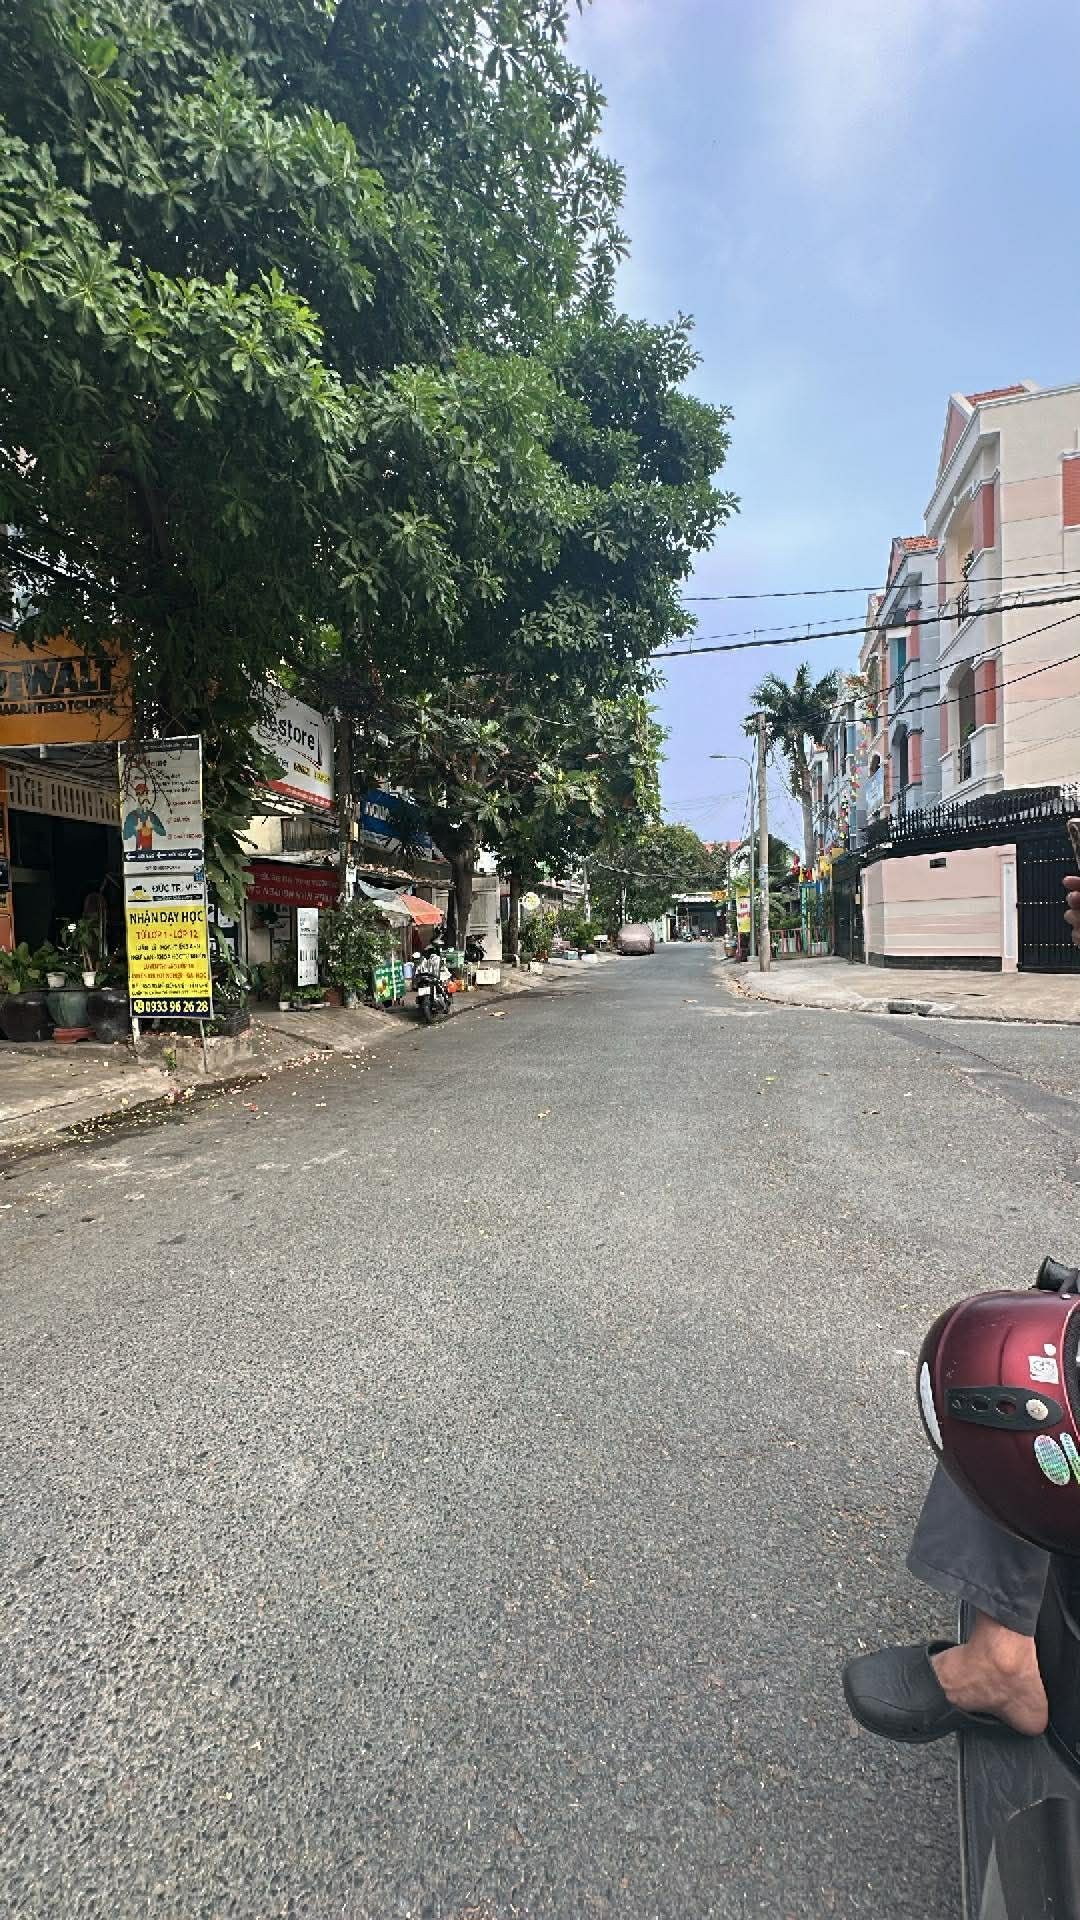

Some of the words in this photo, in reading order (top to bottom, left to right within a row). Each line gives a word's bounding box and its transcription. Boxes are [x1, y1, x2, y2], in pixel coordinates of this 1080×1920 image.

[129, 909, 158, 927] NHẬN
[159, 911, 179, 927] DẠY
[181, 909, 204, 926] HỌC
[189, 929, 199, 939] 12
[146, 1001, 168, 1013] 0933
[169, 1001, 181, 1013] 96
[182, 1001, 194, 1013] 26
[196, 1000, 209, 1012] 28
